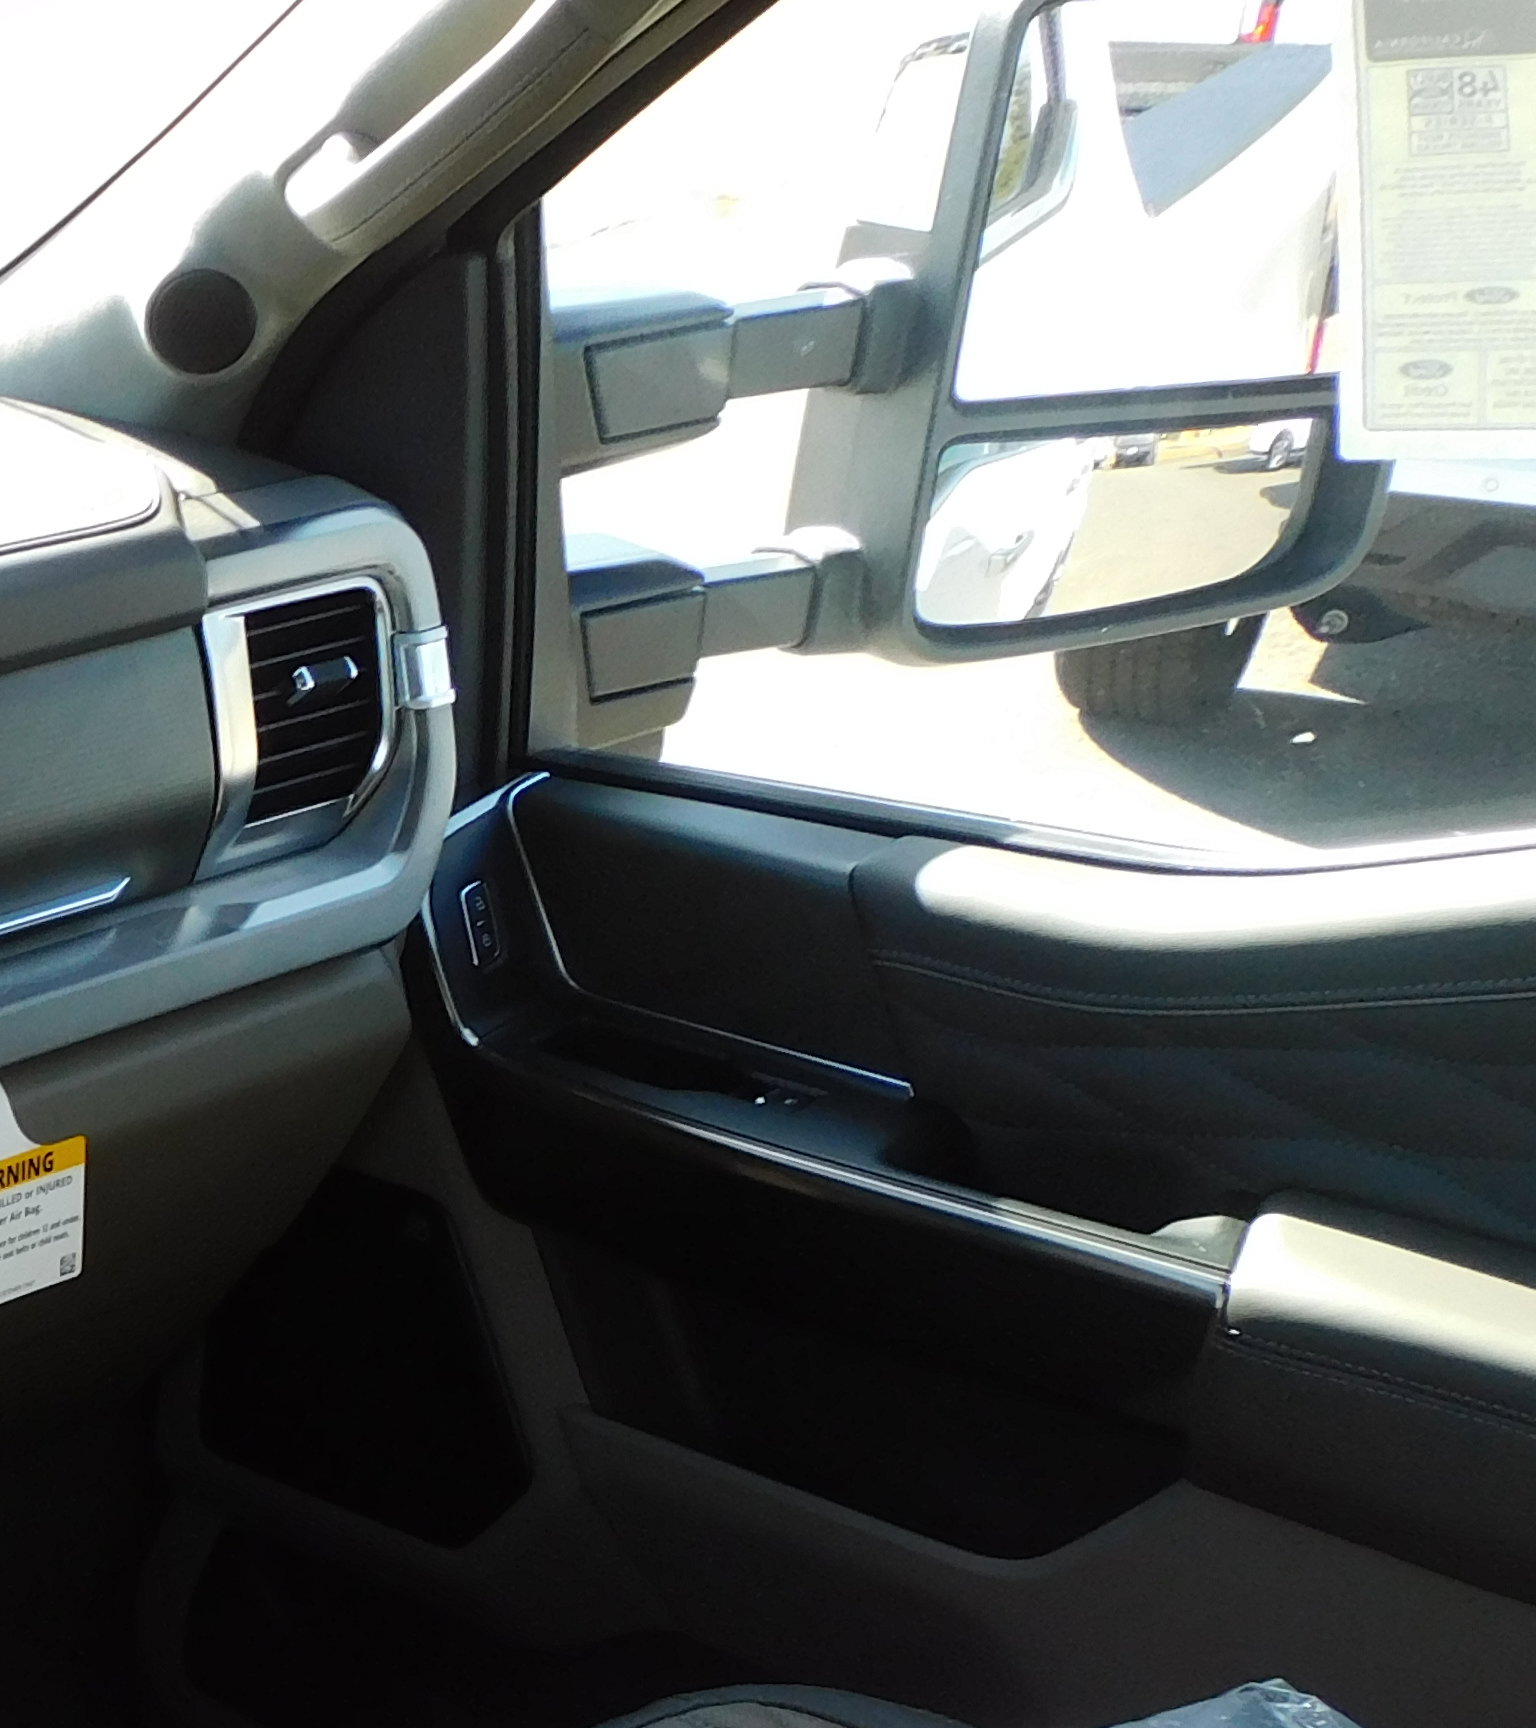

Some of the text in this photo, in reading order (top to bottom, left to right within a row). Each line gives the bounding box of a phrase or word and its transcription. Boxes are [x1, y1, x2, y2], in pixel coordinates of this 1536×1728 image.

[25, 1190, 34, 1199] or
[36, 1175, 73, 1197] INJURED
[10, 1210, 22, 1223] Air
[25, 1205, 43, 1217] Bag.
